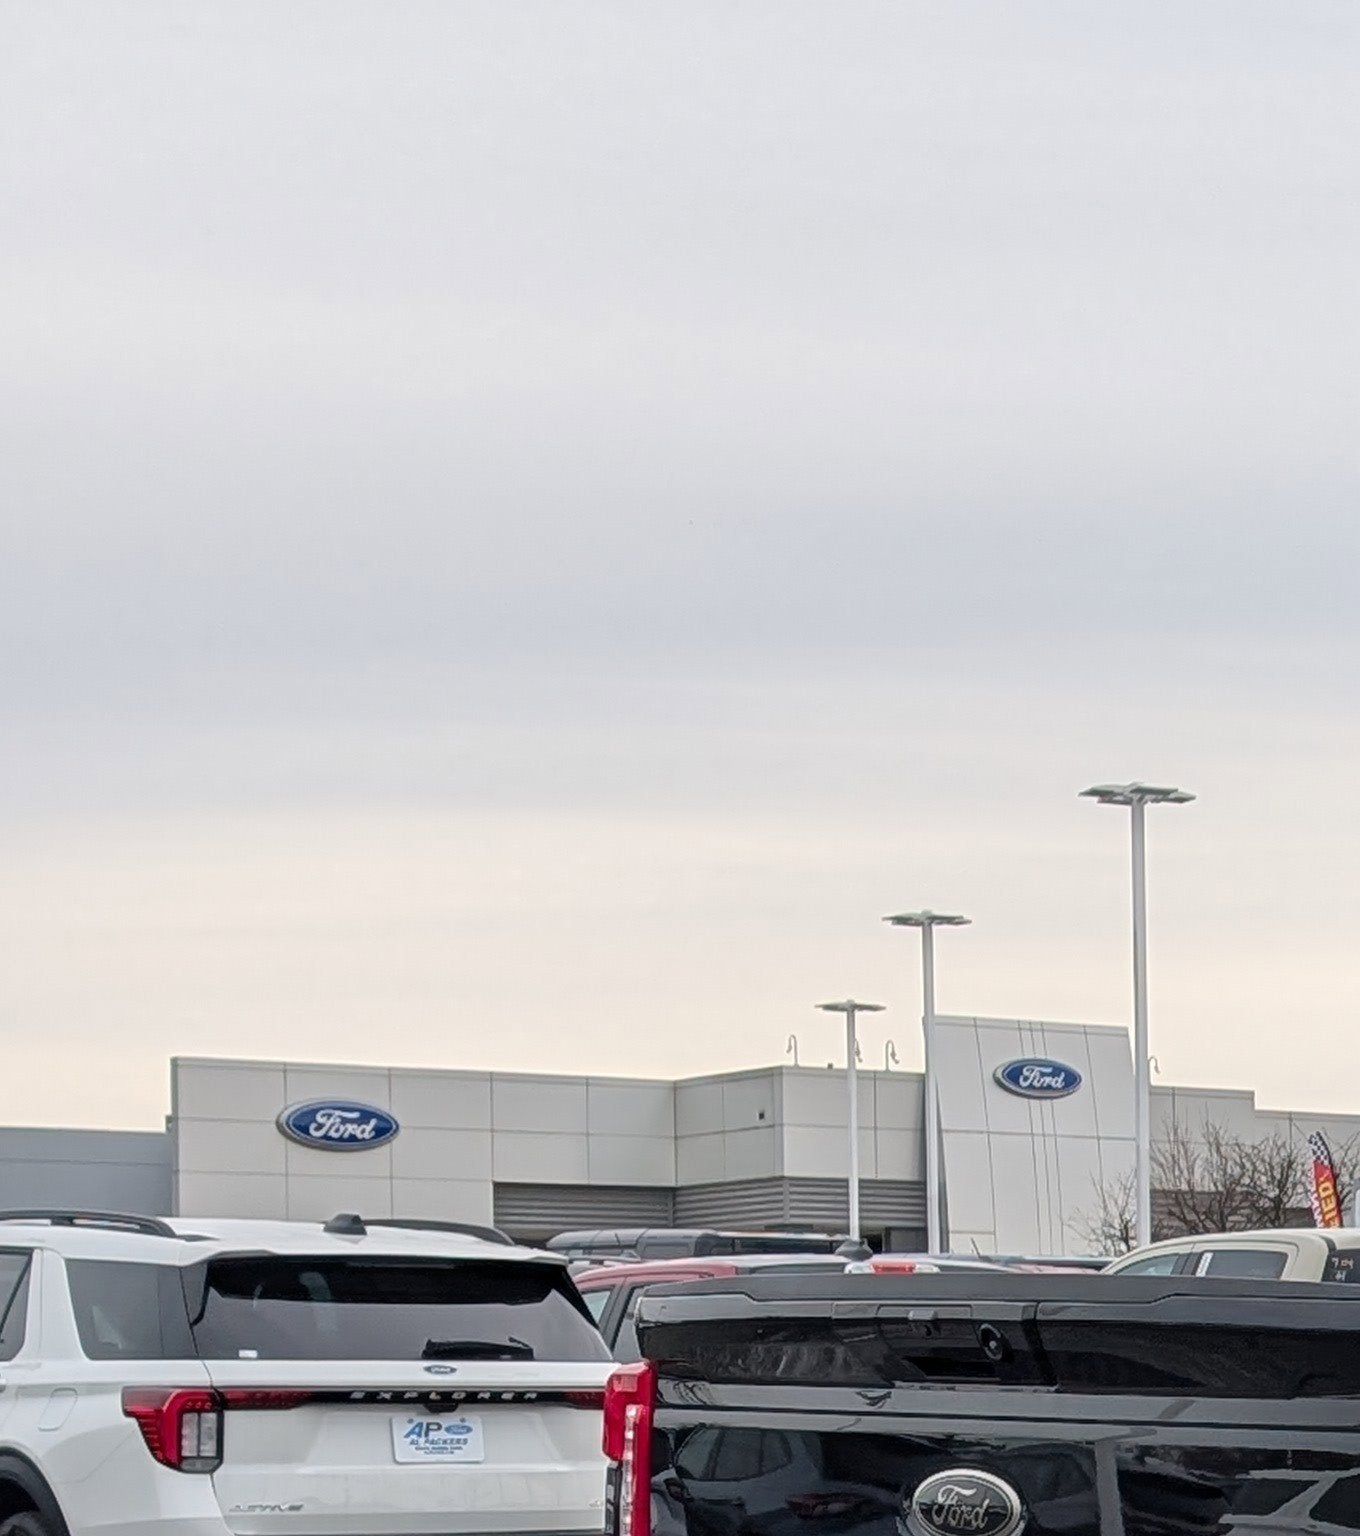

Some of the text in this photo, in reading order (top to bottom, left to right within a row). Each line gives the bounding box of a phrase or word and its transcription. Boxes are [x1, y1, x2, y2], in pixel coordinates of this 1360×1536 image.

[1019, 1065, 1066, 1088] Ford
[308, 1109, 378, 1140] Ford
[403, 1421, 443, 1439] AP
[931, 1484, 989, 1530] Ford
